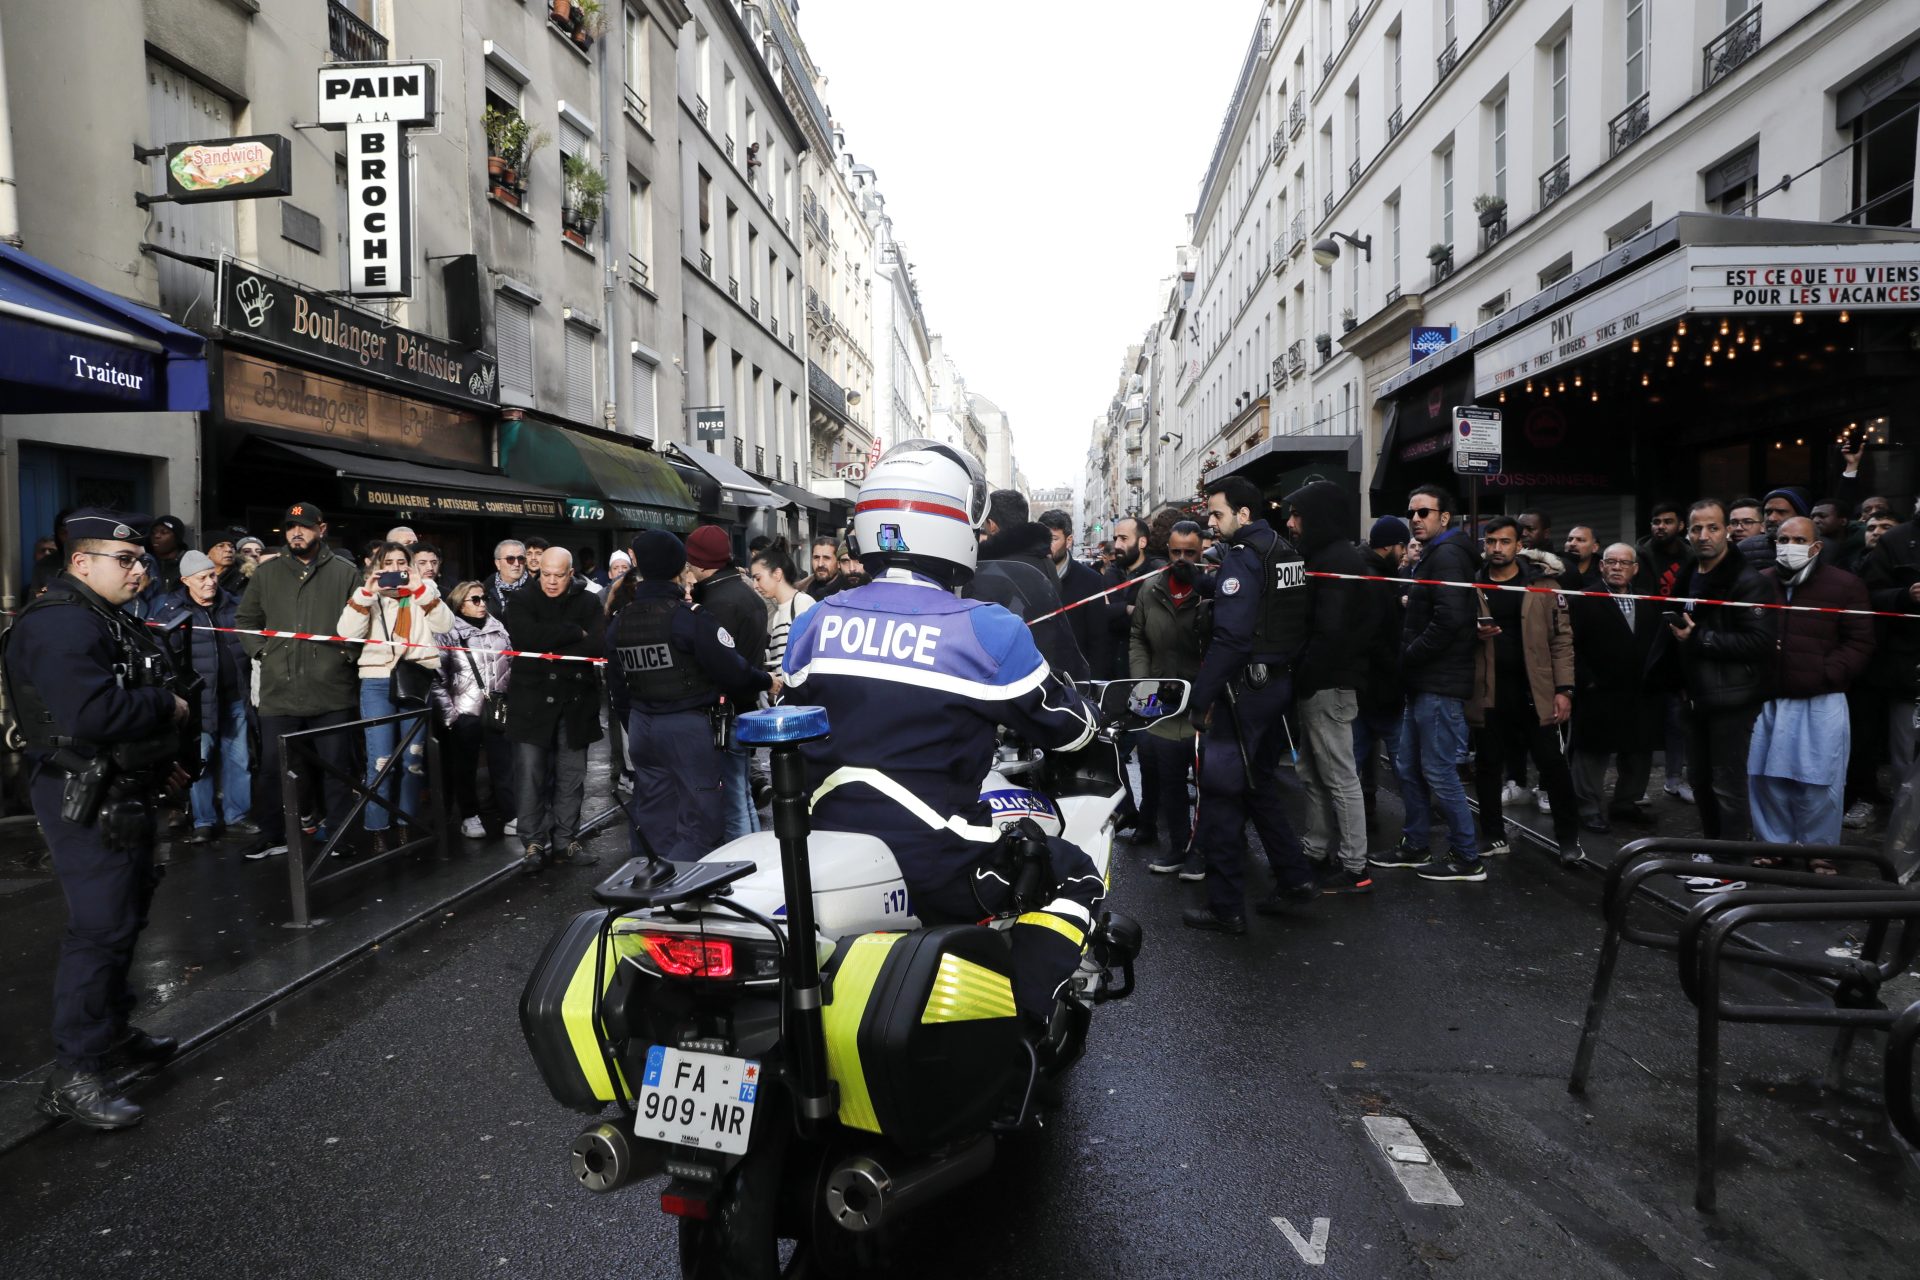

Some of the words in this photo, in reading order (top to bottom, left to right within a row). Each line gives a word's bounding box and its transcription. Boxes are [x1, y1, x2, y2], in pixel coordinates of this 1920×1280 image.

[325, 75, 419, 100] PAIN
[374, 112, 390, 122] LA
[193, 146, 263, 166] Sandwich
[361, 132, 387, 287] BROCHE
[1726, 270, 1757, 286] EST
[1764, 269, 1785, 286] CE
[1790, 268, 1827, 285] QUE
[1834, 268, 1856, 284] TU
[1865, 266, 1919, 283] VIENS
[1733, 288, 1781, 305] POUR
[1790, 287, 1821, 304] LES
[1828, 285, 1920, 304] VACANCES
[292, 294, 387, 366] Boulanger
[396, 332, 463, 385] Pâtissier
[1551, 311, 1574, 345] PNY
[1494, 368, 1515, 384] SERVING
[1533, 351, 1553, 369] FINEST
[1559, 336, 1586, 358] BURGERS
[1596, 322, 1617, 342] SINCE
[1623, 312, 1640, 331] 2012
[69, 354, 143, 390] Traiteur
[254, 371, 367, 433] Boulangerie
[698, 421, 724, 431] nysa
[1484, 474, 1608, 487] POISSONNERIE
[368, 491, 430, 508] BOULANGERIE
[437, 498, 480, 512] PATISSERIE
[485, 502, 523, 514] CONFISERIE
[818, 615, 942, 666] POLICE
[618, 645, 669, 670] POLICE
[988, 796, 1039, 811] OLIC
[889, 888, 906, 913] 17
[649, 1071, 657, 1081] F
[674, 1061, 705, 1093] FA
[741, 1084, 755, 1100] 75
[644, 1092, 746, 1136] 909-NR
